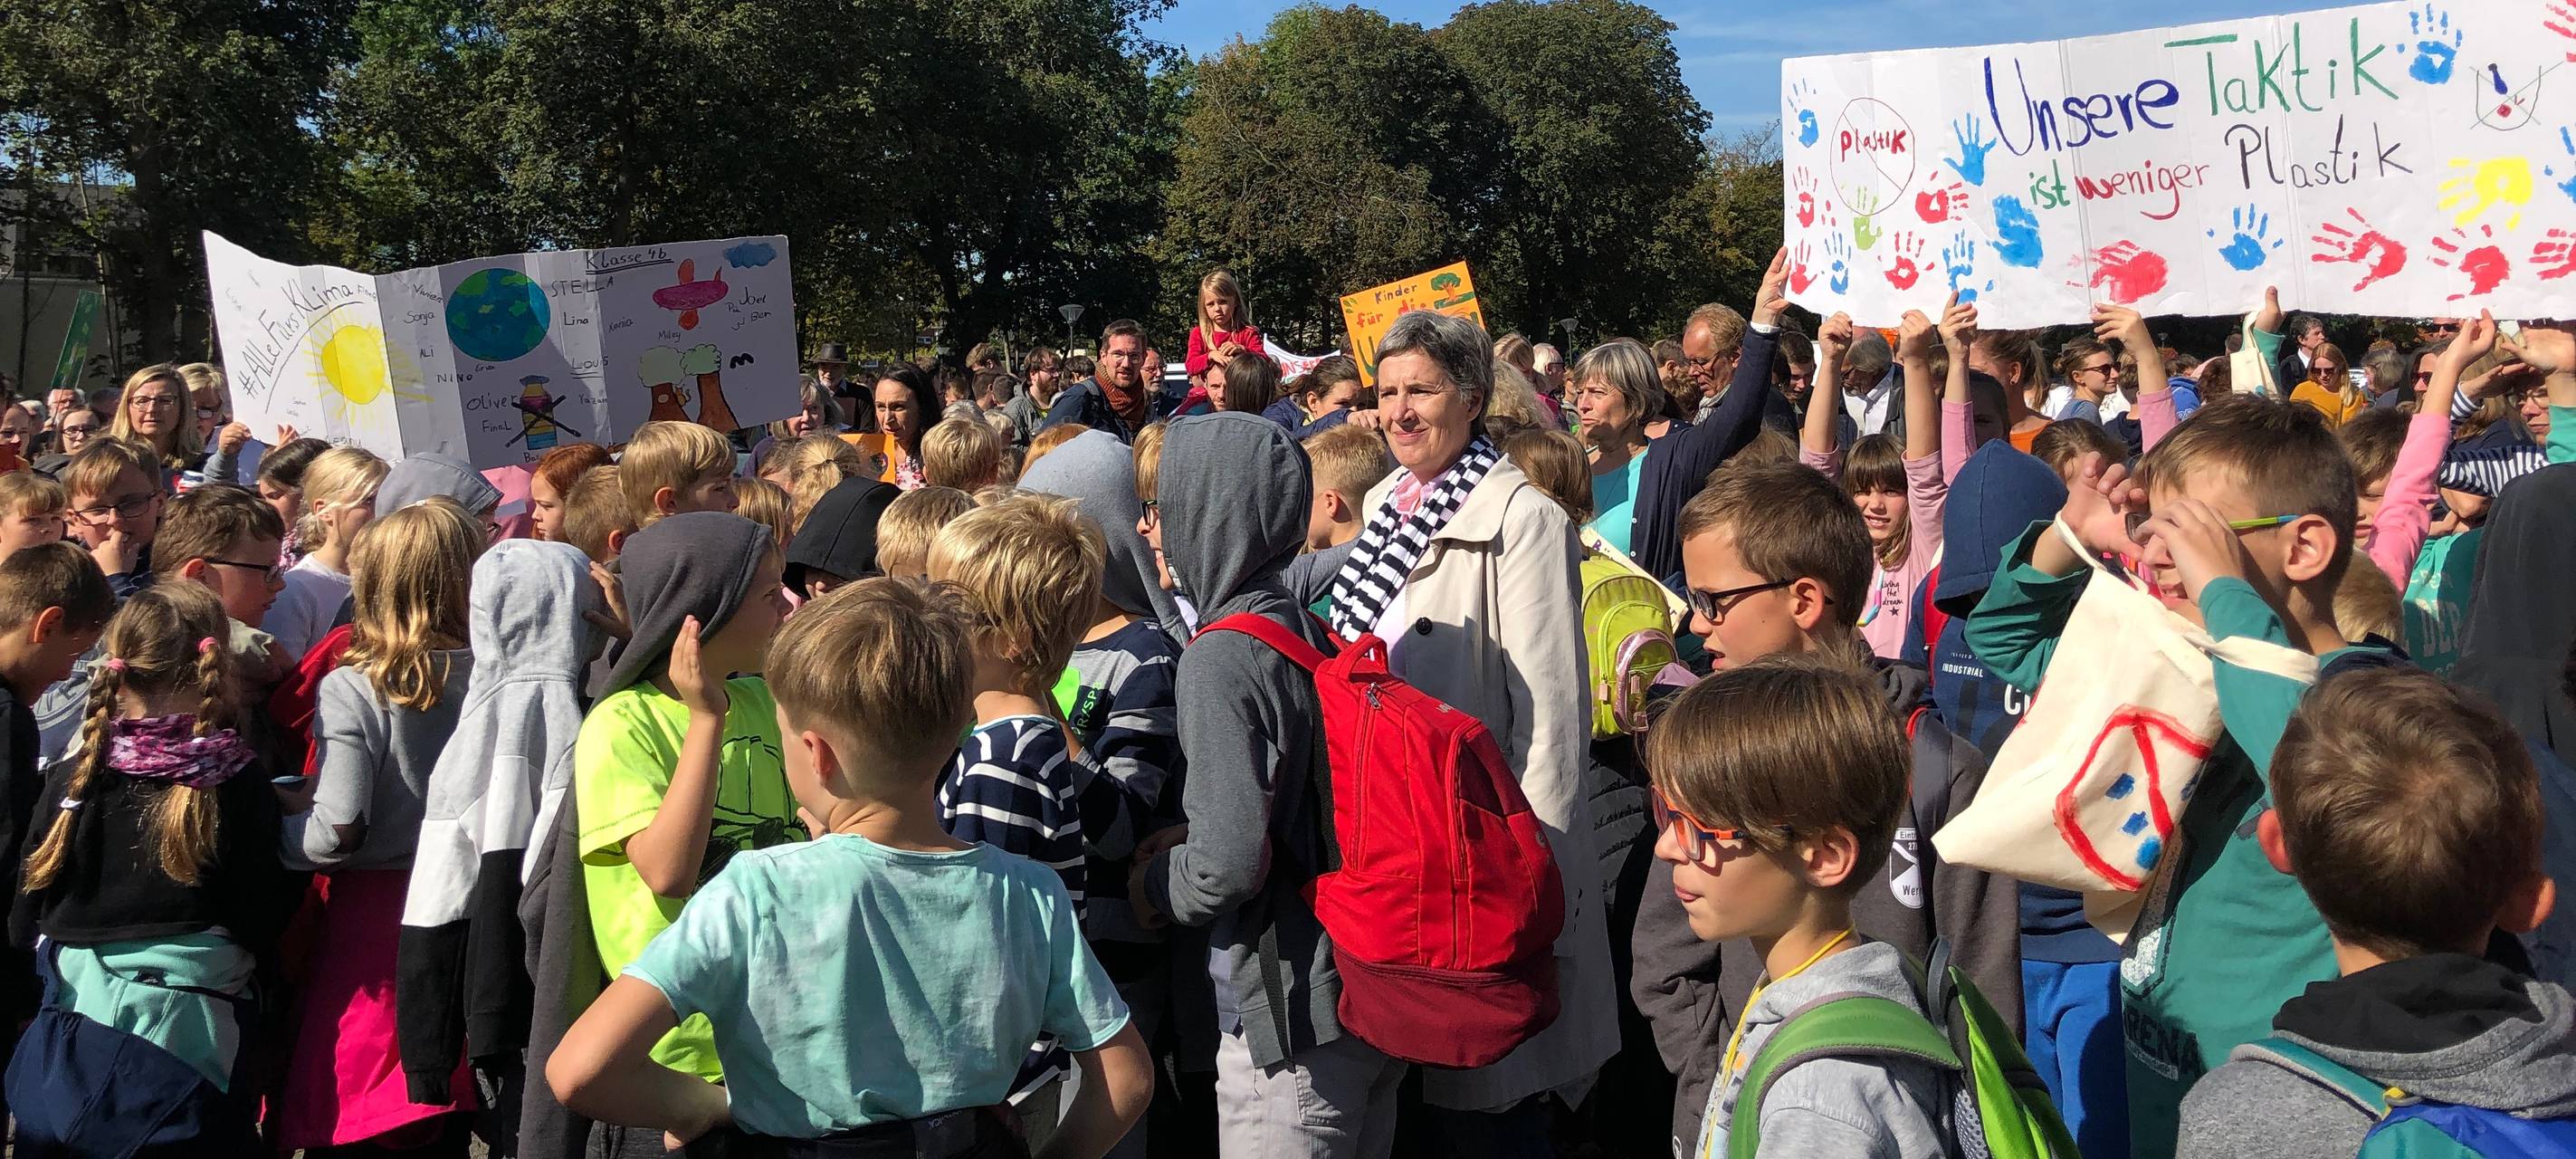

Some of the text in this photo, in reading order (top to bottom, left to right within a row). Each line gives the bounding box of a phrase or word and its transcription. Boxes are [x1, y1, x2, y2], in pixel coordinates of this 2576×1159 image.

[1984, 56, 2180, 157] Unsere
[2029, 158, 2071, 210] ist
[2075, 159, 2210, 221] weniger
[586, 247, 667, 269] Klasse 4b
[551, 275, 614, 298] STELLA
[1375, 284, 1417, 304] Kinder
[404, 310, 434, 326] Sonja
[564, 311, 588, 326] Lina
[1357, 312, 1383, 328] für
[466, 392, 518, 411] Oliver
[1942, 663, 1984, 678] INDUSTRIAL
